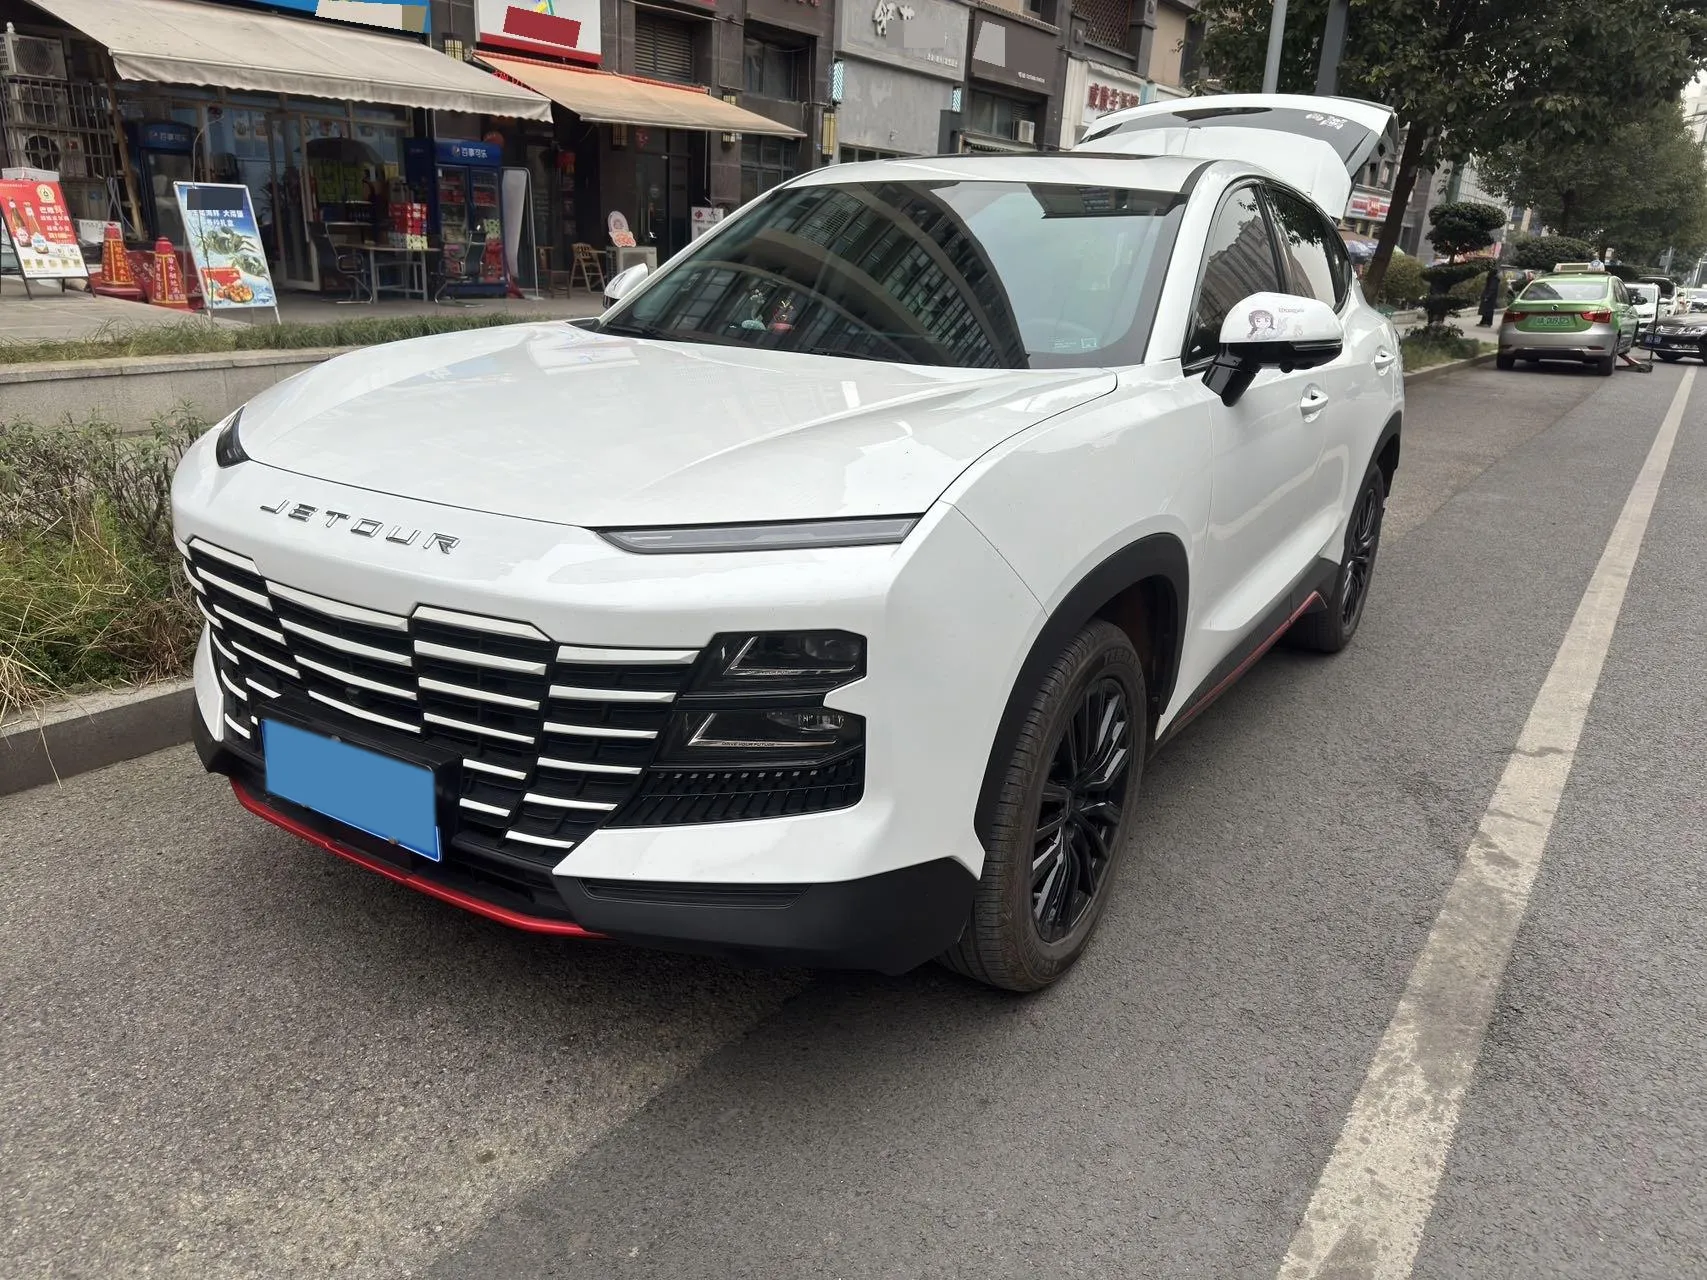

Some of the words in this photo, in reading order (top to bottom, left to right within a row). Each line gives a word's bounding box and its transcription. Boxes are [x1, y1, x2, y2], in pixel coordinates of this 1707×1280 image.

[461, 147, 488, 158] 百事可乐
[259, 498, 461, 555] JETOUR
